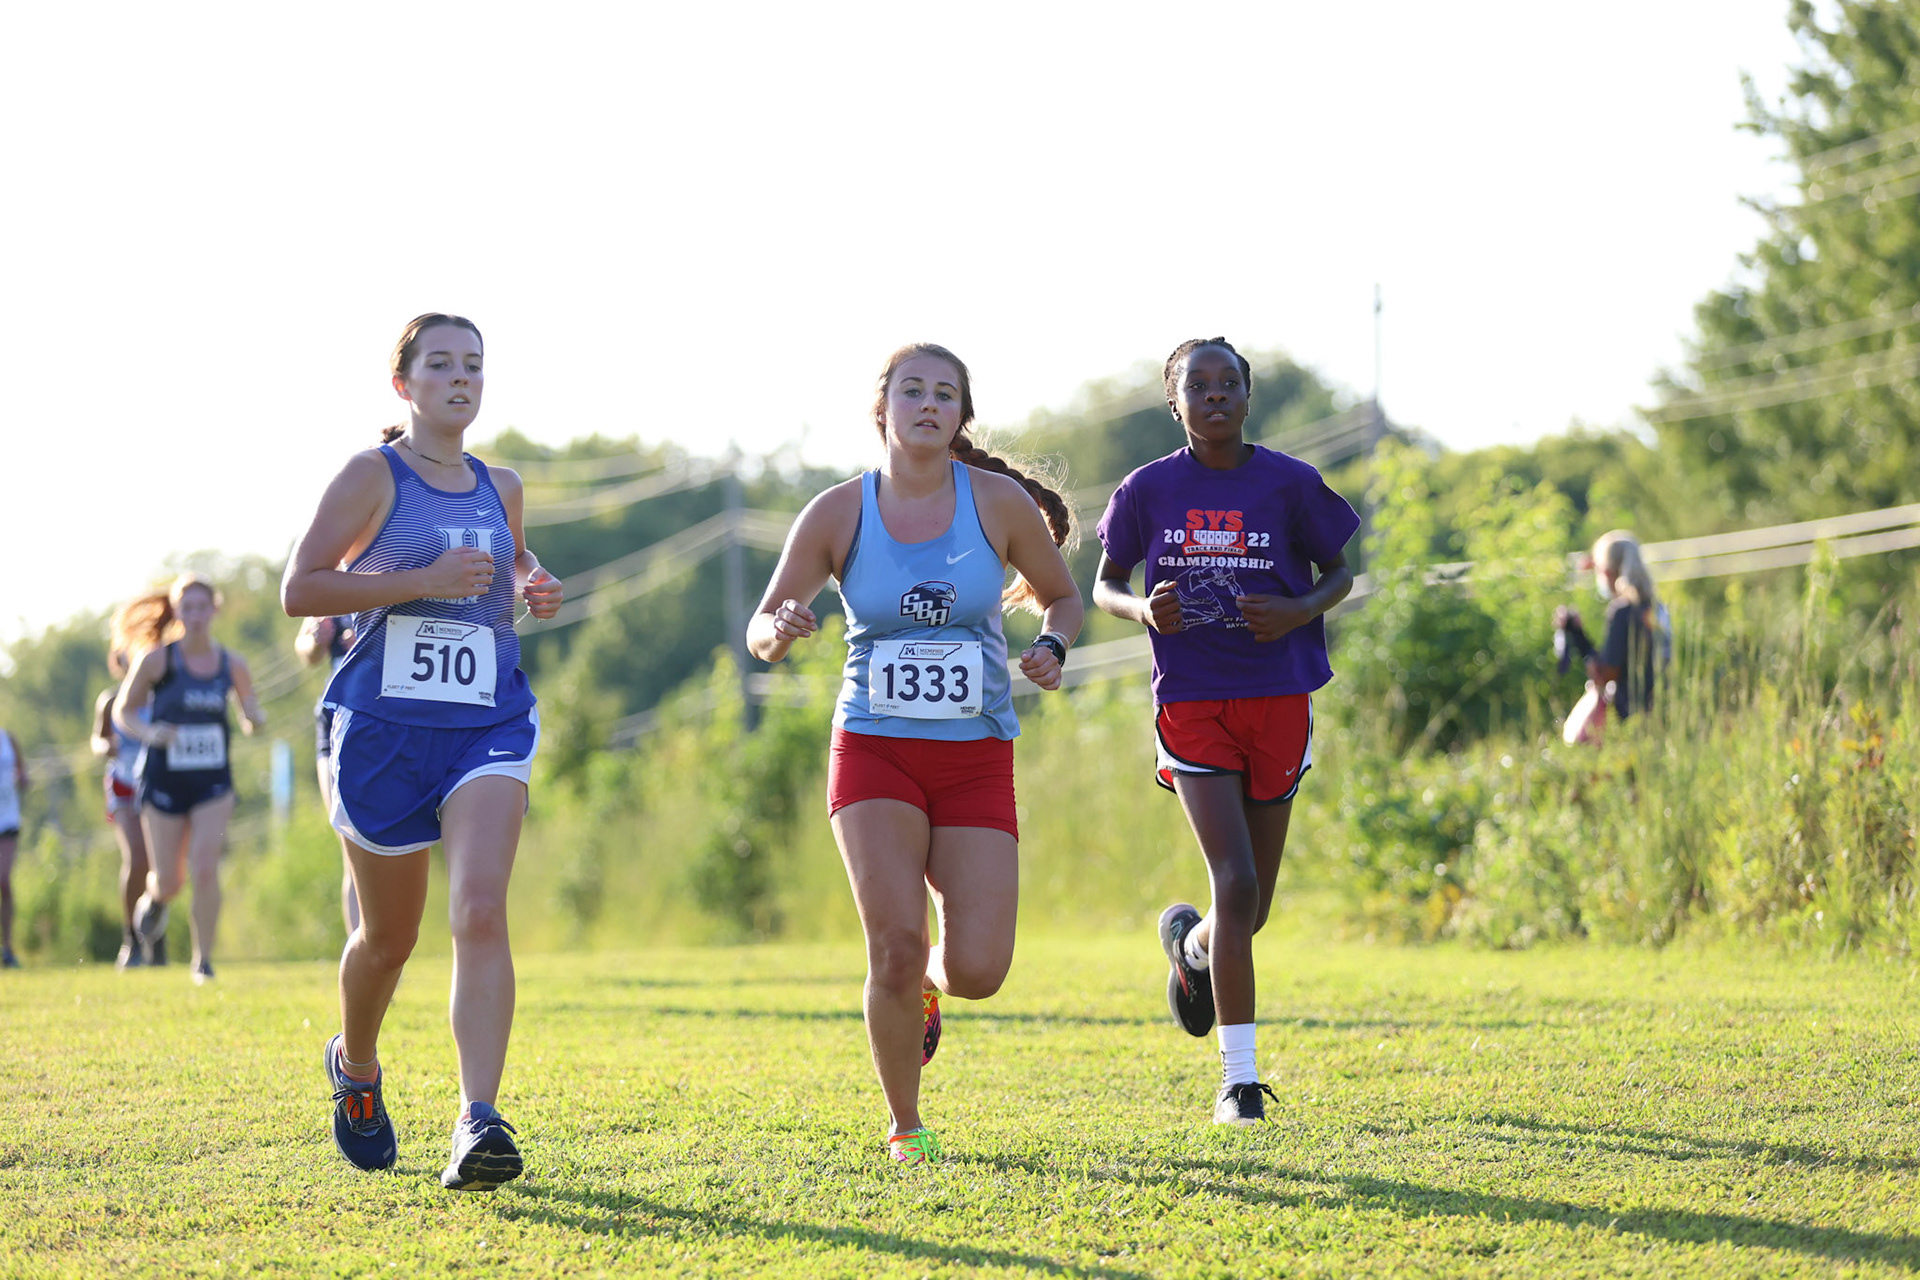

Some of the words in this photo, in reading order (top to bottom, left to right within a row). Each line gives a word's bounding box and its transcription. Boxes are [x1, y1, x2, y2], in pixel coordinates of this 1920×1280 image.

[1186, 509, 1243, 531] SYS
[1164, 529, 1185, 544] 20
[1247, 532, 1270, 547] 22
[1158, 556, 1274, 570] CHAMPIONSHIP
[902, 593, 948, 626] SBA
[422, 624, 435, 634] M
[904, 647, 916, 656] M
[410, 642, 477, 685] 510
[882, 663, 969, 702] 1333
